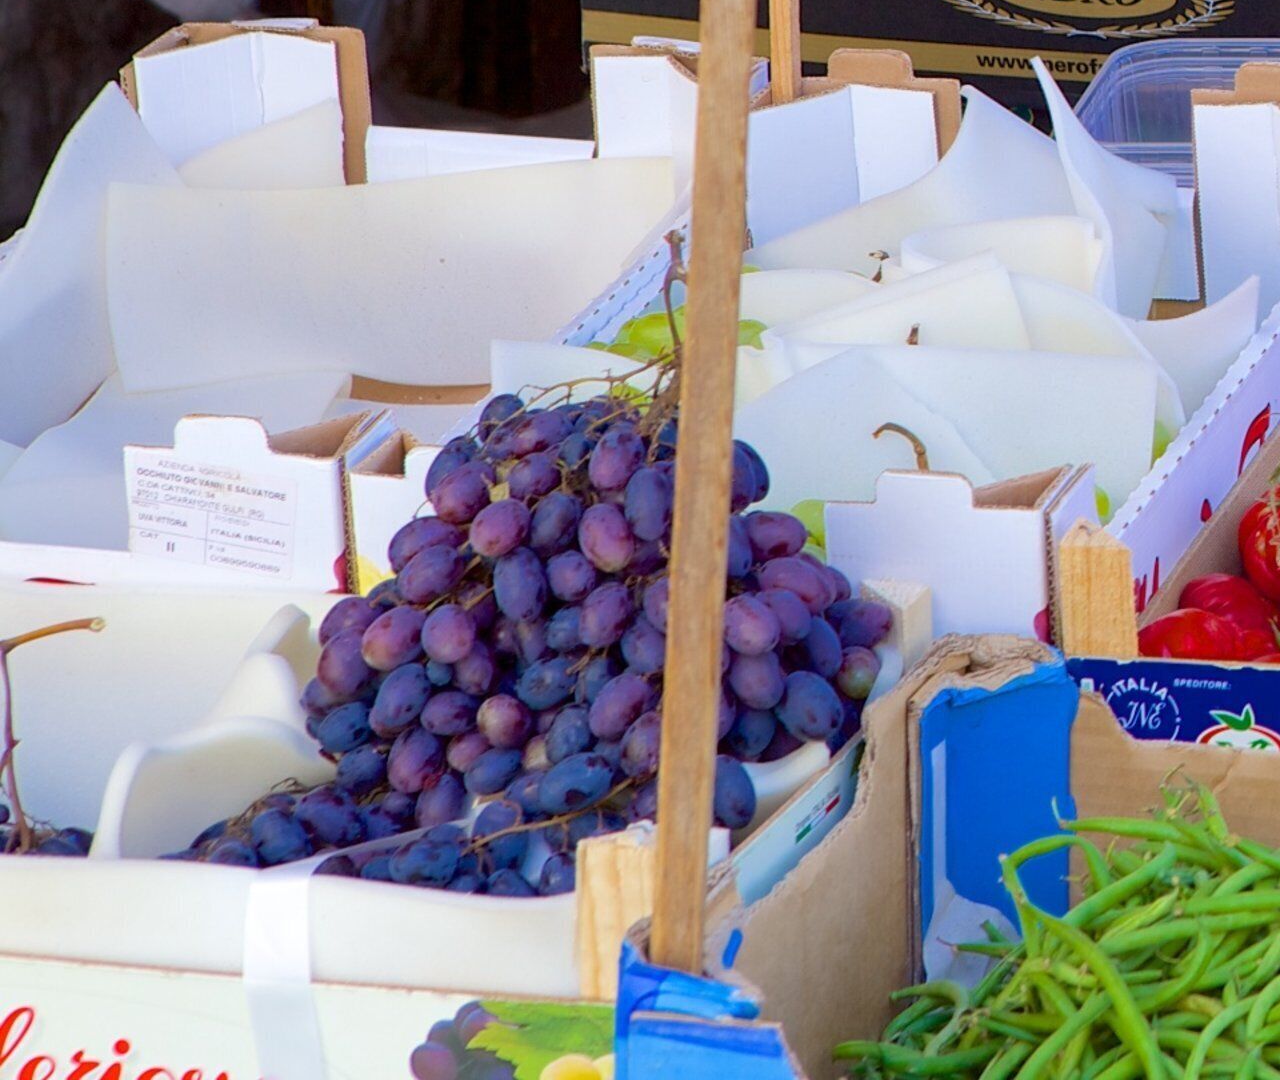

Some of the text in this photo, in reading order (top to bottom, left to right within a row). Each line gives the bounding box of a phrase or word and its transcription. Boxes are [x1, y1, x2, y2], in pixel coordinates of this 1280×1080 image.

[976, 54, 1104, 76] wwwnerof
[235, 484, 288, 502] SALVATORE
[138, 512, 154, 524] UVA
[210, 528, 286, 549] ITALIA (SICILIA)
[1111, 677, 1169, 701] ITALIA
[1173, 677, 1232, 691] SPEDITORE:
